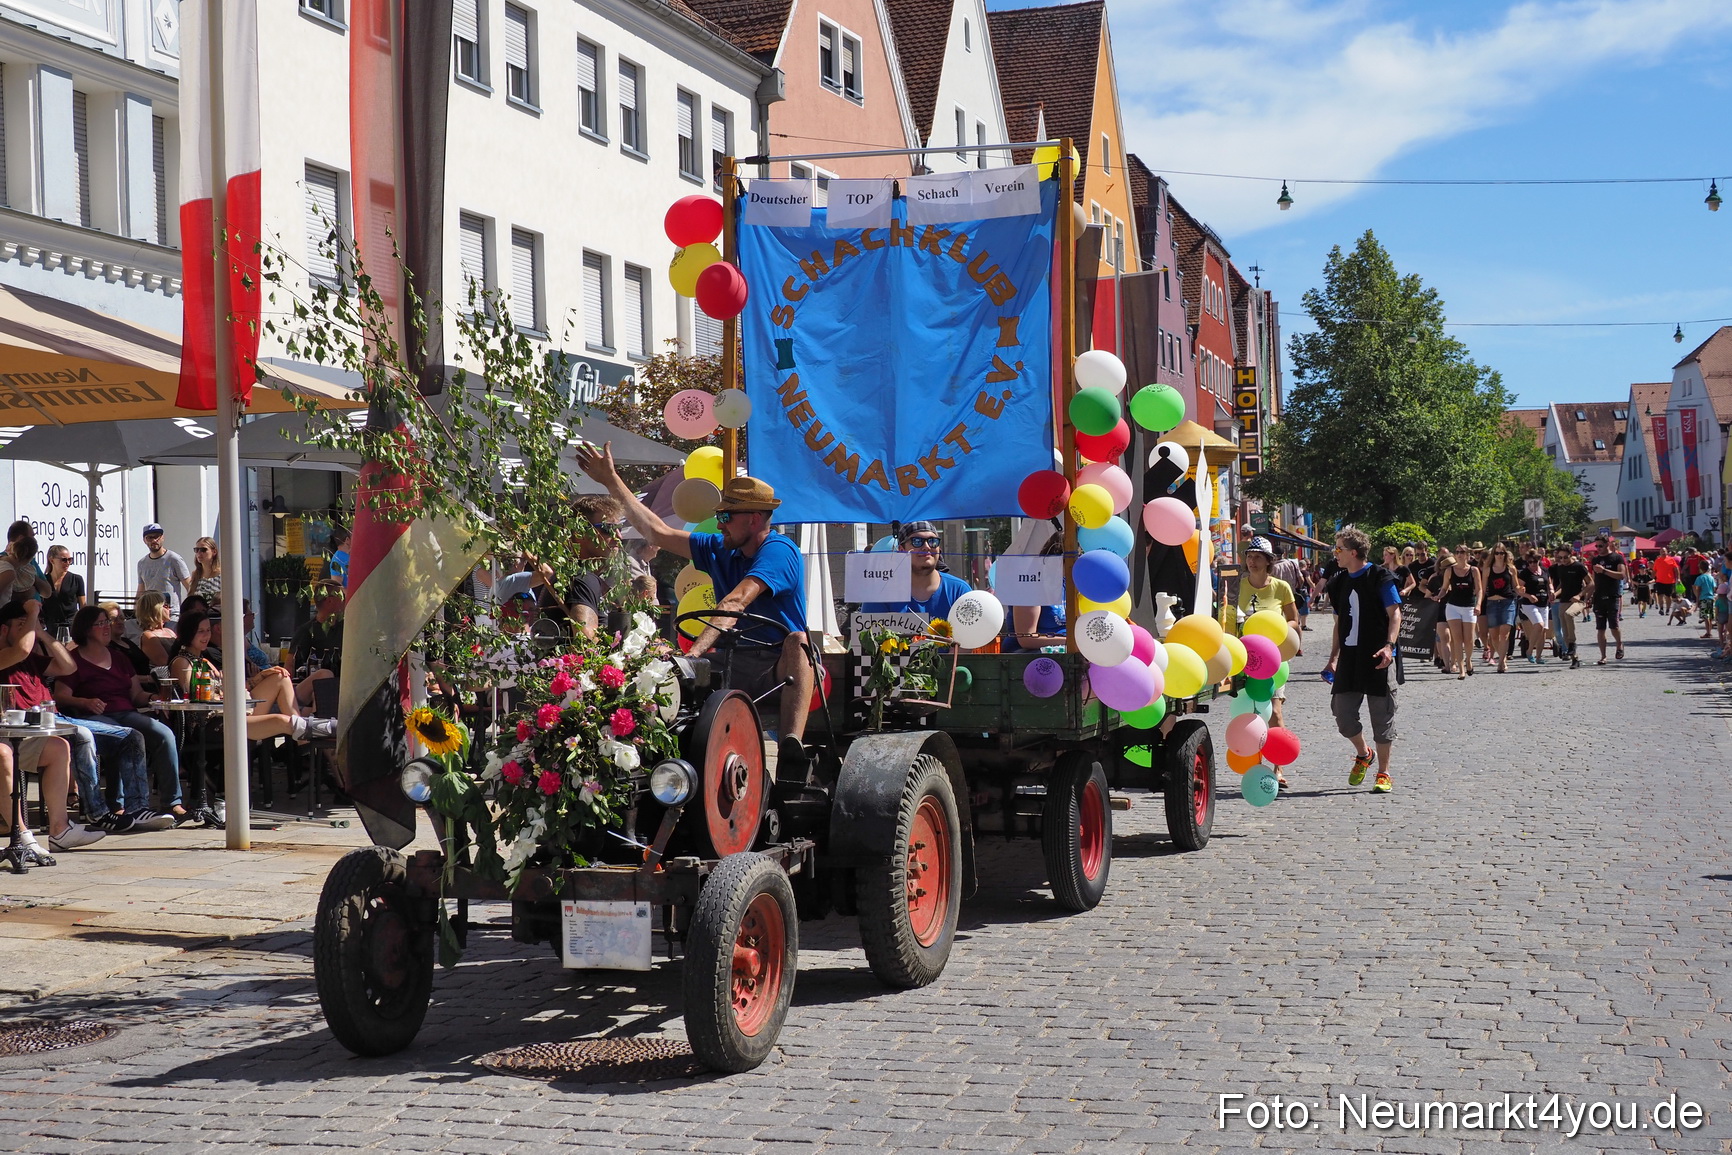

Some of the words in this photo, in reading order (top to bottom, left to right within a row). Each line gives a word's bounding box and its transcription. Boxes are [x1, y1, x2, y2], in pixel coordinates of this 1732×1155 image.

[750, 192, 808, 205] Deutscher
[846, 193, 874, 205] TOP
[917, 186, 960, 201] Schach
[984, 181, 1025, 196] Verein
[770, 218, 1018, 330] SCHACHKLUB
[1237, 369, 1258, 477] HOTEL
[776, 372, 974, 497] NEUMARKT
[41, 482, 61, 507] 30
[60, 517, 69, 536] &
[863, 568, 894, 581] taugt
[1018, 571, 1042, 582] ma!
[855, 614, 924, 634] Schachklub
